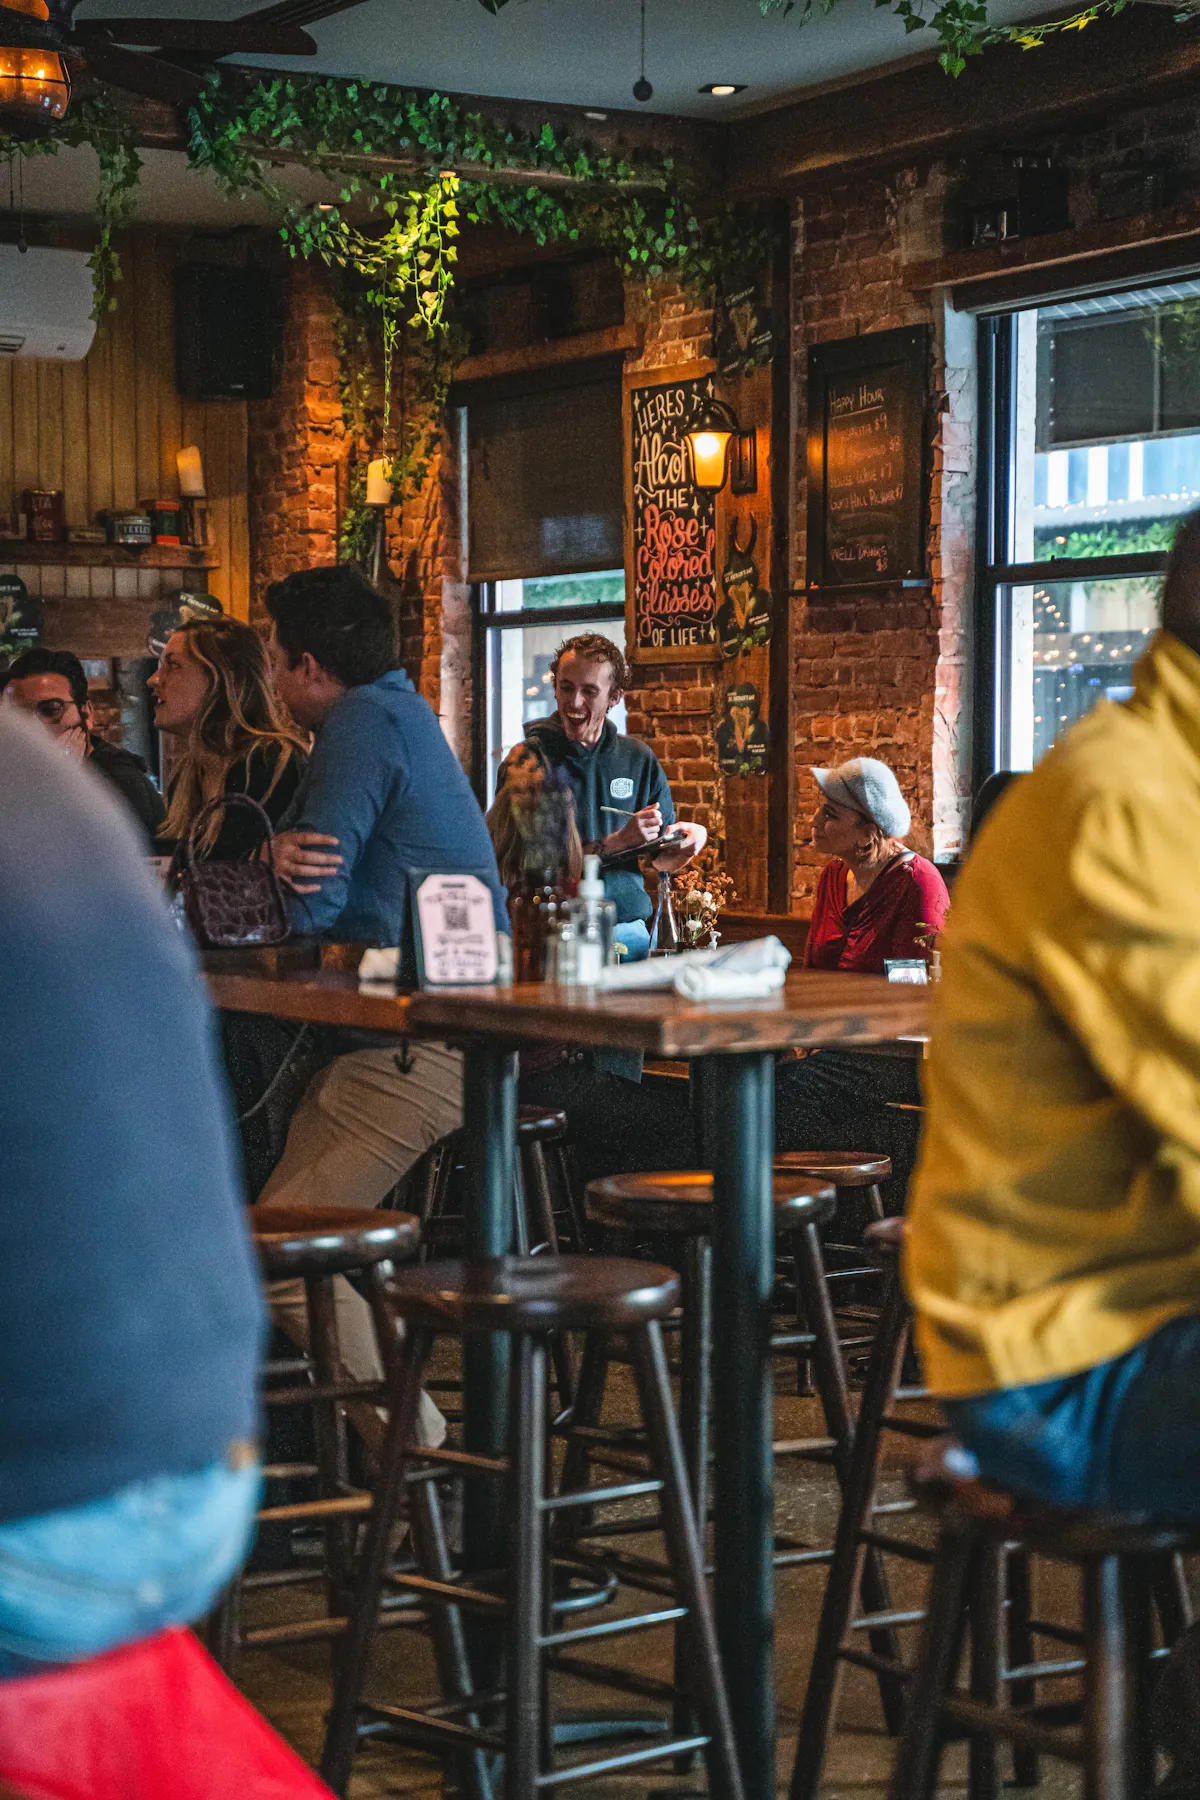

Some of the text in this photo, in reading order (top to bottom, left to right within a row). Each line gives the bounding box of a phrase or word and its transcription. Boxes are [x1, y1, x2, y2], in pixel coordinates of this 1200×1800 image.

[637, 389, 704, 434] HERES T
[657, 487, 689, 508] THE
[644, 503, 700, 549] Rose
[637, 528, 715, 583] Colored
[640, 580, 715, 637] glasses
[652, 627, 698, 646] OF LIFE
